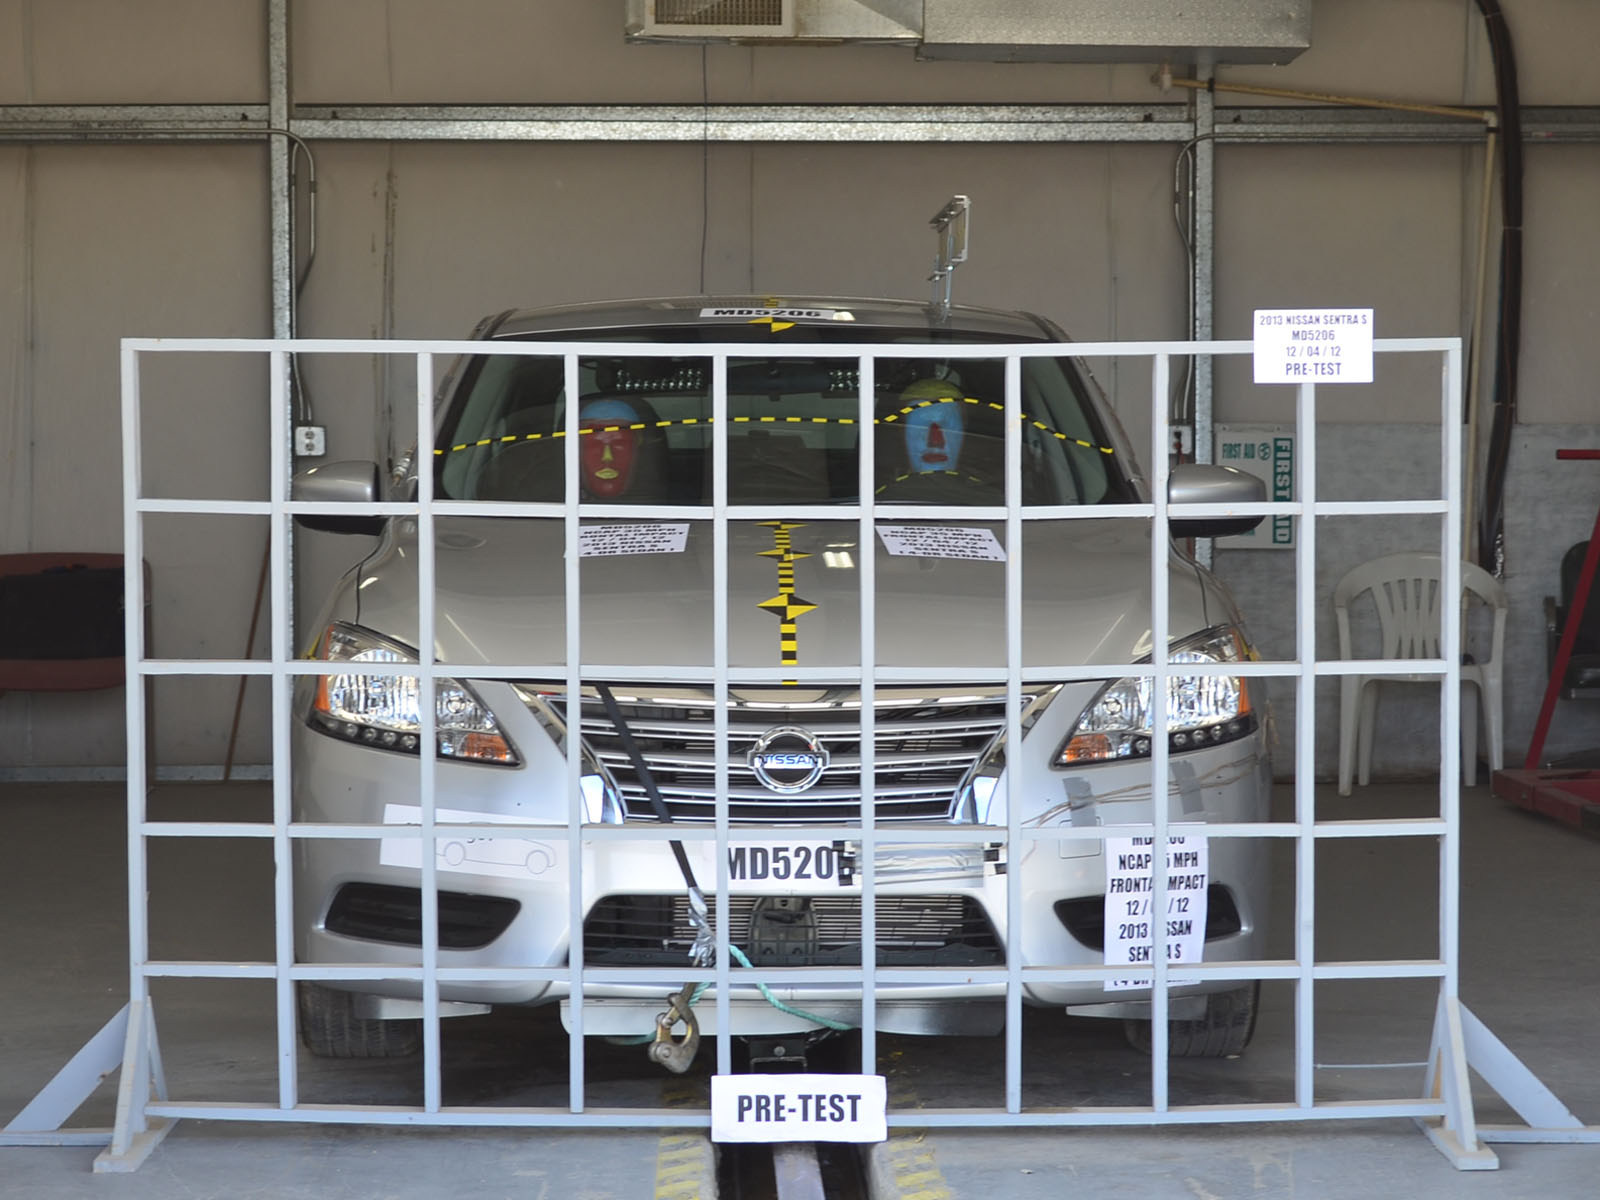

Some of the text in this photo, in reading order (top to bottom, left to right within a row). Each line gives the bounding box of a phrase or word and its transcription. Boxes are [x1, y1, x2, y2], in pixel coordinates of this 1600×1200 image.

[713, 309, 821, 317] MD5206
[1260, 314, 1367, 325] 2013 NISSAN SENTRA S
[1292, 330, 1335, 340] MD5206
[1286, 346, 1296, 356] 12
[1307, 346, 1320, 357] 04
[1331, 346, 1341, 356] 12
[1285, 362, 1342, 375] PRE-TEST
[1276, 440, 1290, 499] FIRST
[757, 754, 820, 766] NISSAN
[728, 846, 835, 880] MD520
[1118, 854, 1152, 870] NCAP
[1174, 851, 1198, 868] MPH
[1167, 874, 1206, 891] MPACT
[1126, 900, 1139, 916] 12
[1177, 897, 1189, 913] 12
[1119, 922, 1148, 940] 2013
[1175, 943, 1181, 959] S
[738, 1094, 861, 1122] PRE-TEST
